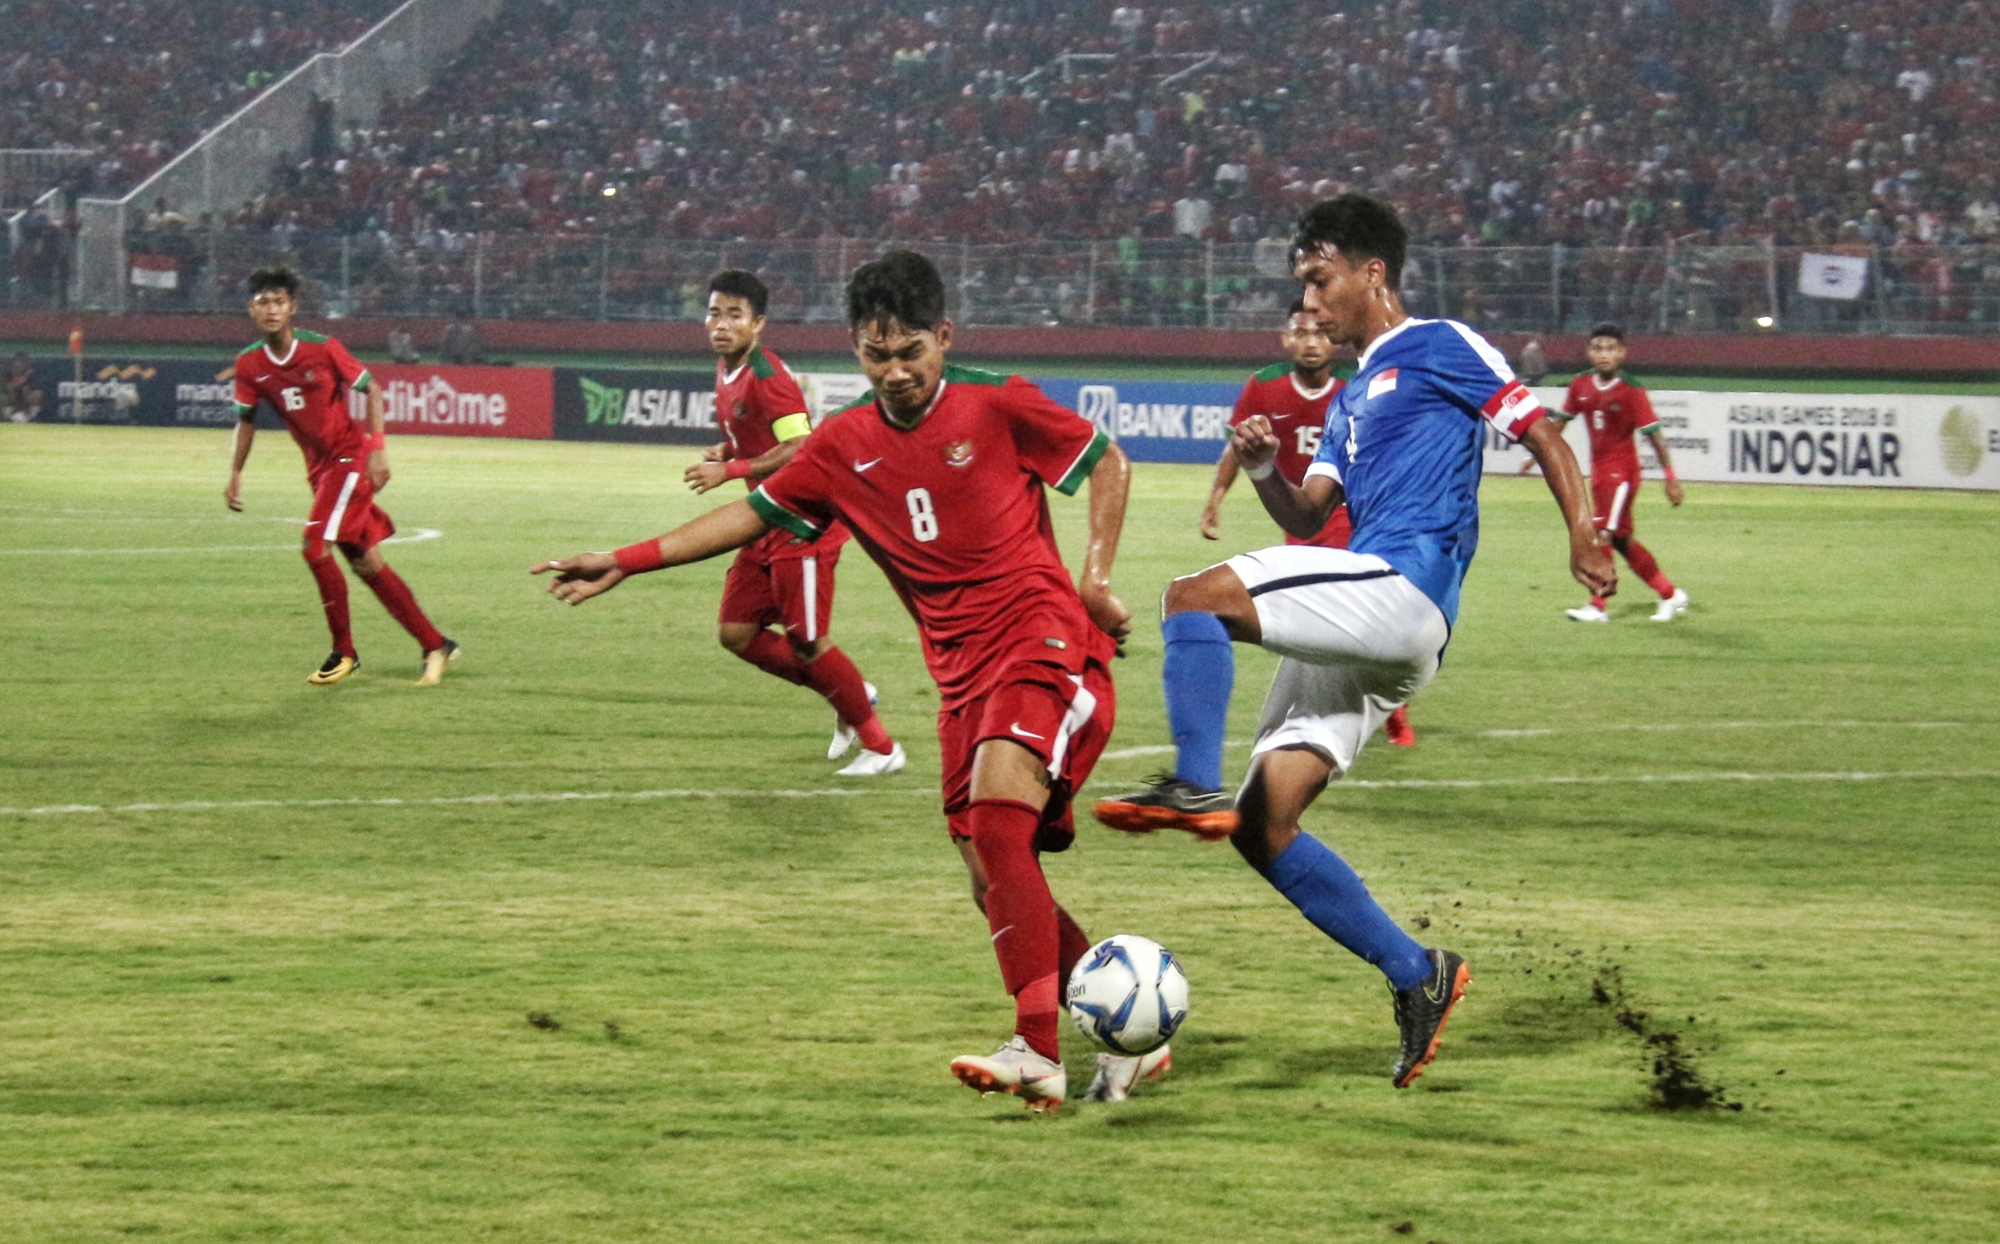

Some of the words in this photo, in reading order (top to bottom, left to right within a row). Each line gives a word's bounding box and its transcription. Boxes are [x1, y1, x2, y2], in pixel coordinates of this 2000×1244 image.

[281, 386, 305, 410] 16
[1117, 403, 1188, 438] BANK
[1593, 410, 1604, 430] 6
[1728, 405, 1776, 425] ASIAN
[1781, 405, 1835, 426] GAMES
[1840, 406, 1879, 427] 2018
[1294, 425, 1322, 455] 15
[1729, 429, 1901, 477] INDOSIAR
[906, 487, 939, 542] 8
